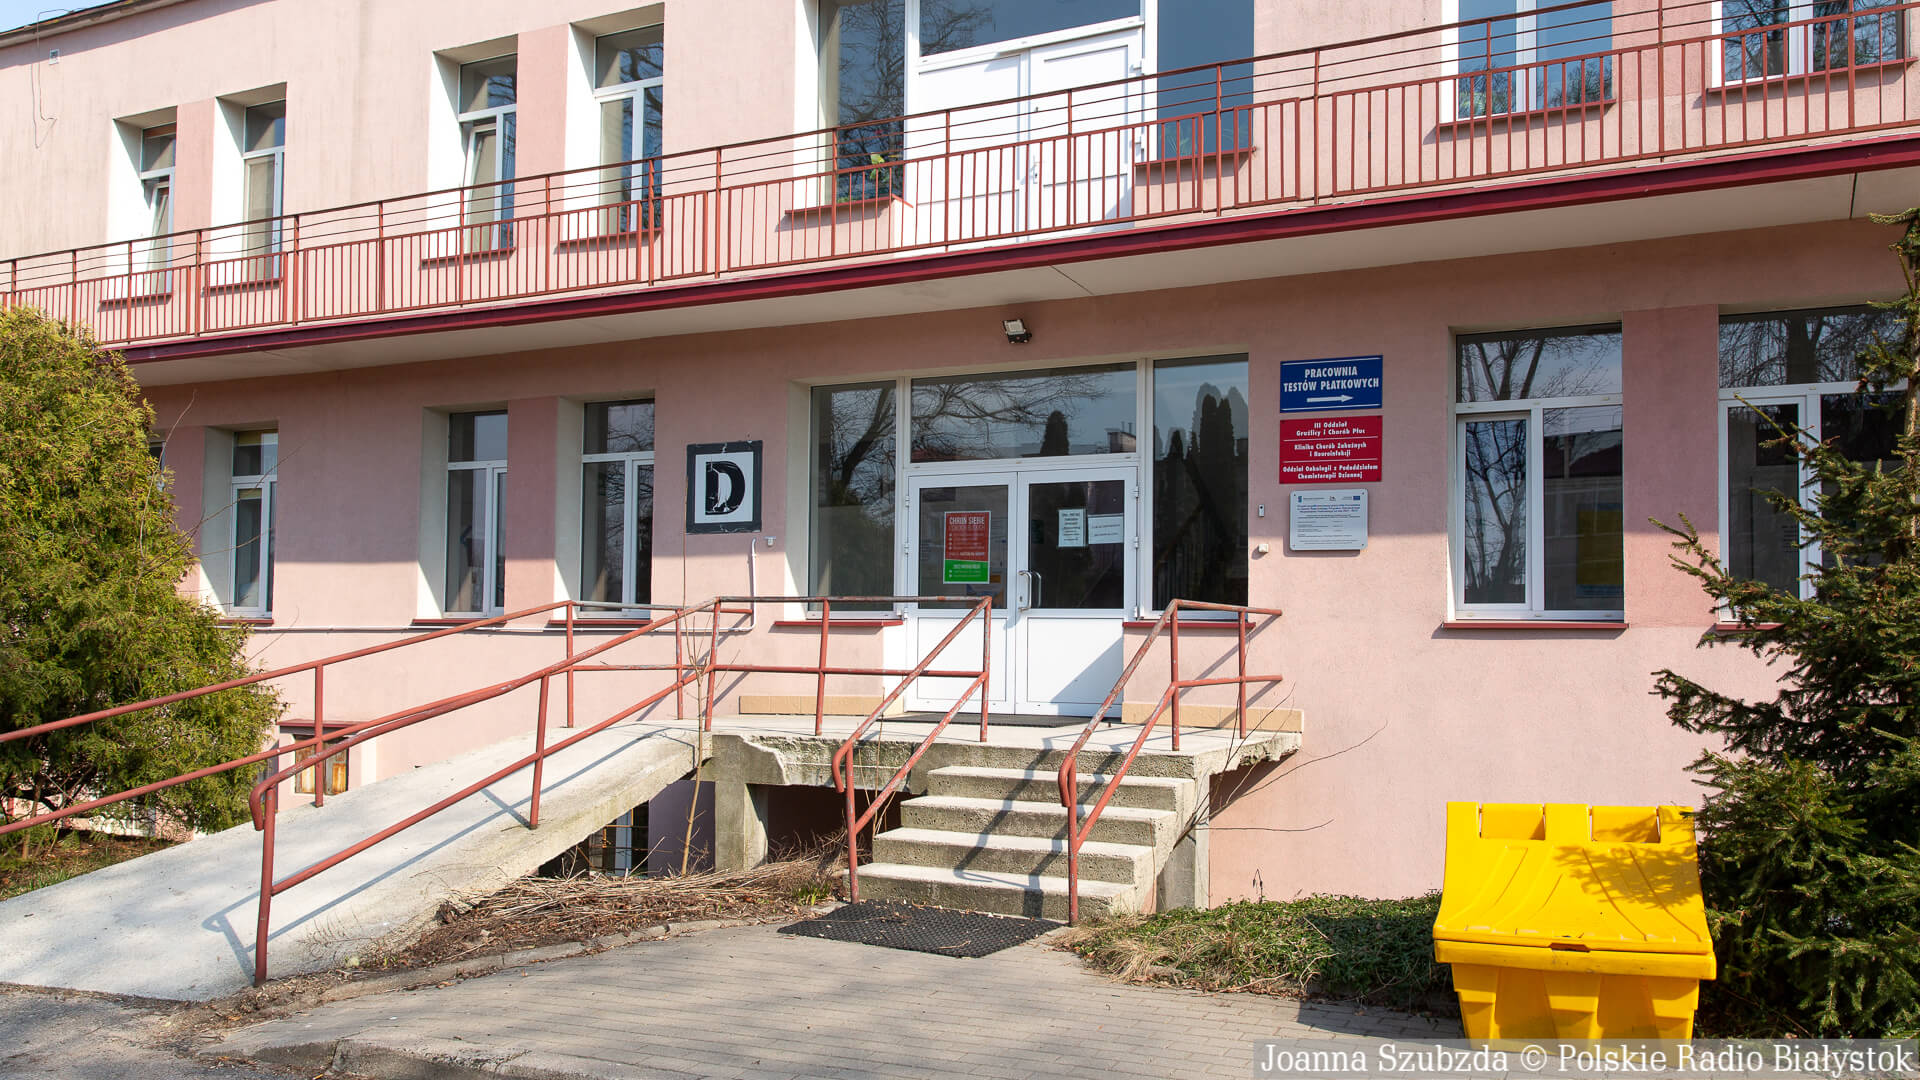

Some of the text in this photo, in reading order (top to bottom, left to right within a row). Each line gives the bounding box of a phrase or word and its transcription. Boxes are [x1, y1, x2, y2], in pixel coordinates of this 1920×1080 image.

[1304, 366, 1358, 378] PRACOWNIA
[1283, 378, 1380, 394] TESTÓW PŁATKOWYCH
[1297, 472, 1337, 480] Chemioterapii
[705, 461, 745, 515] D
